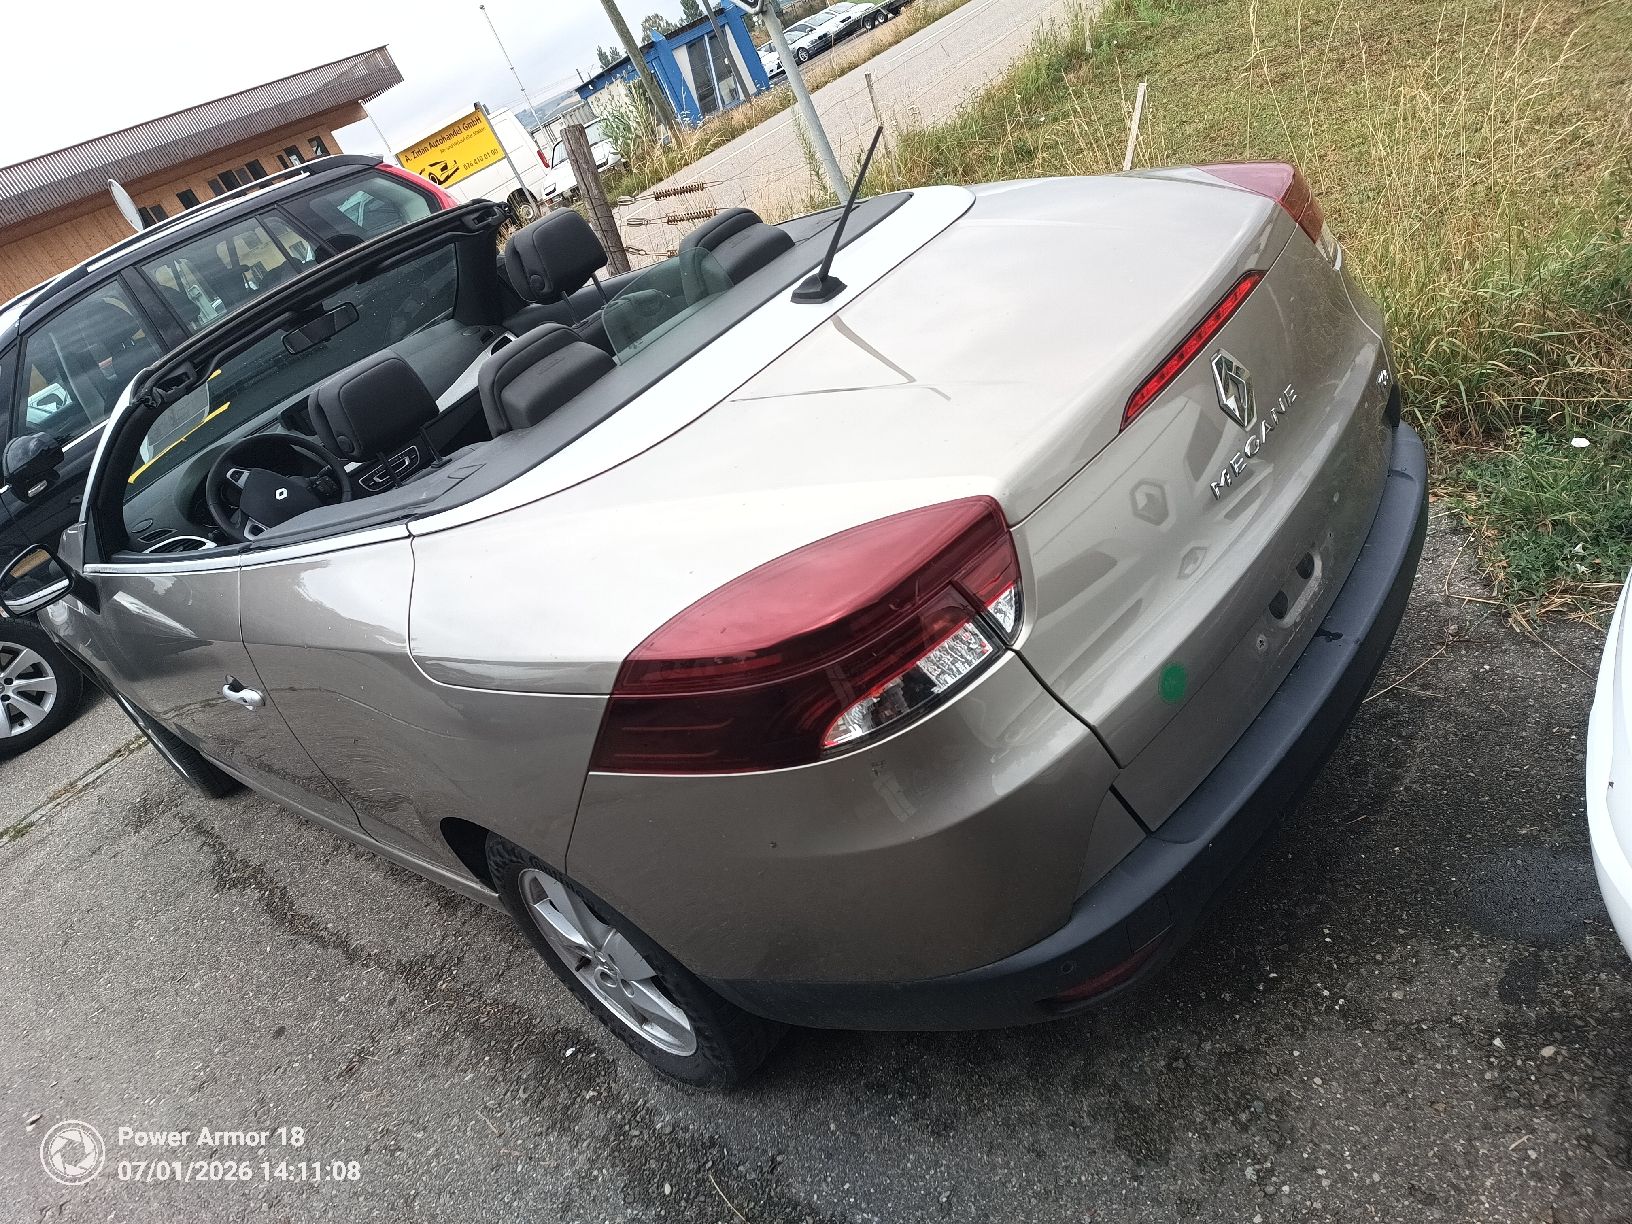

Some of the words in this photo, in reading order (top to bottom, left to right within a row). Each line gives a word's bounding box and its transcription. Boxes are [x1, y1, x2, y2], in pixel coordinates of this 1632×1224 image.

[429, 126, 463, 149] Autohandel
[463, 116, 482, 131] GmbH
[1210, 383, 1298, 501] MEGANE
